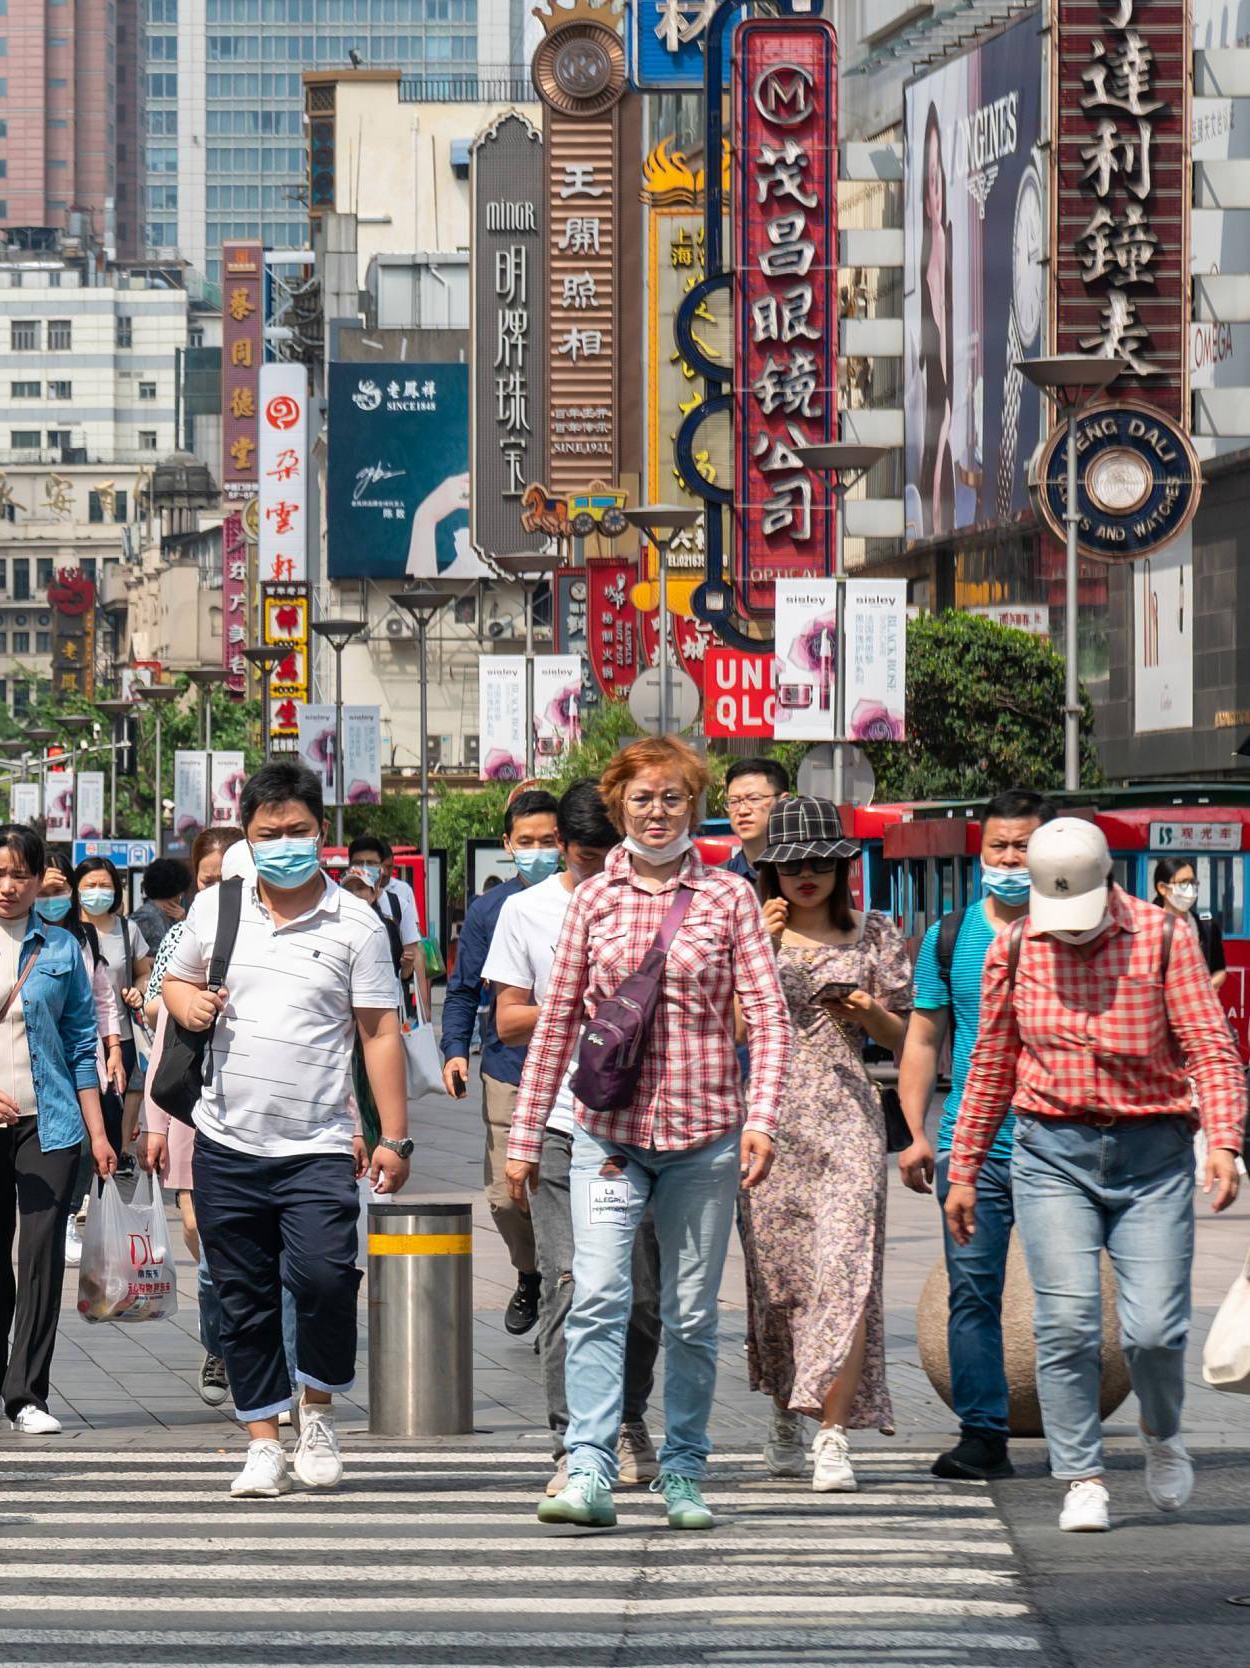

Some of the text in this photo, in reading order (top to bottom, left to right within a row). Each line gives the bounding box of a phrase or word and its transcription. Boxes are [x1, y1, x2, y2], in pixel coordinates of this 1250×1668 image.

[557, 163, 603, 362] 王開照相
[494, 244, 530, 497] 明牌珠宝
[1128, 418, 1177, 462] DALI
[1096, 525, 1126, 541] AND
[1134, 476, 1180, 537] WATCHES
[786, 594, 826, 605] sisley
[856, 595, 896, 606] sisley
